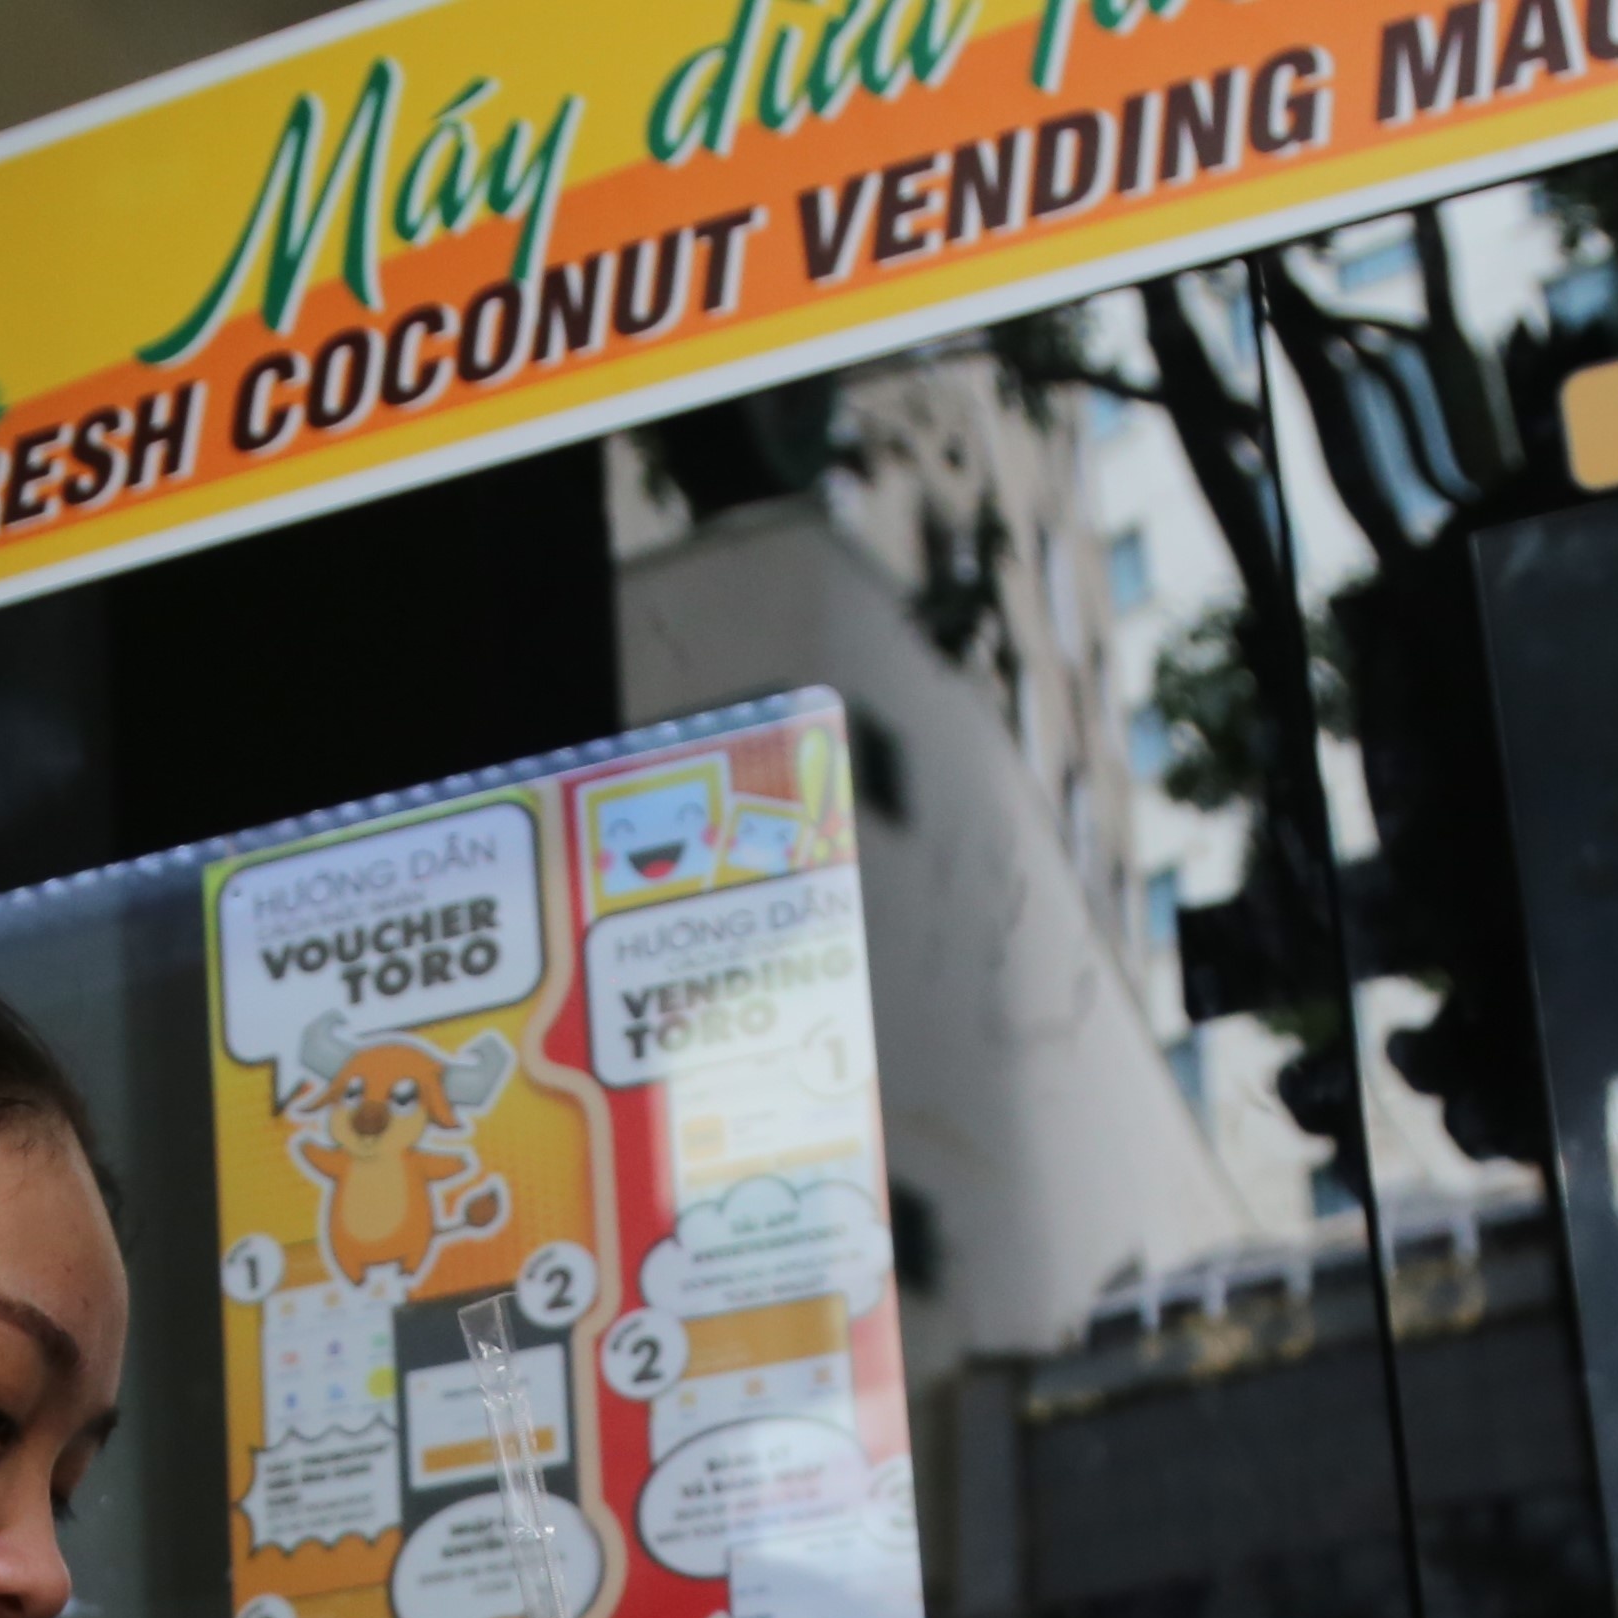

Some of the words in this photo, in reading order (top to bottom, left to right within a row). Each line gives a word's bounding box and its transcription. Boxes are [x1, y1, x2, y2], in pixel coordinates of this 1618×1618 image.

[136, 56, 586, 363] Máy
[231, 205, 768, 454] COCONUT
[796, 45, 1334, 285] VENDING
[259, 895, 499, 981] VOUCHER
[341, 936, 501, 1006] TORO
[620, 942, 856, 1019] VENDING
[623, 992, 778, 1060] TORO
[544, 1266, 574, 1311] 2
[629, 1335, 664, 1383] 2
